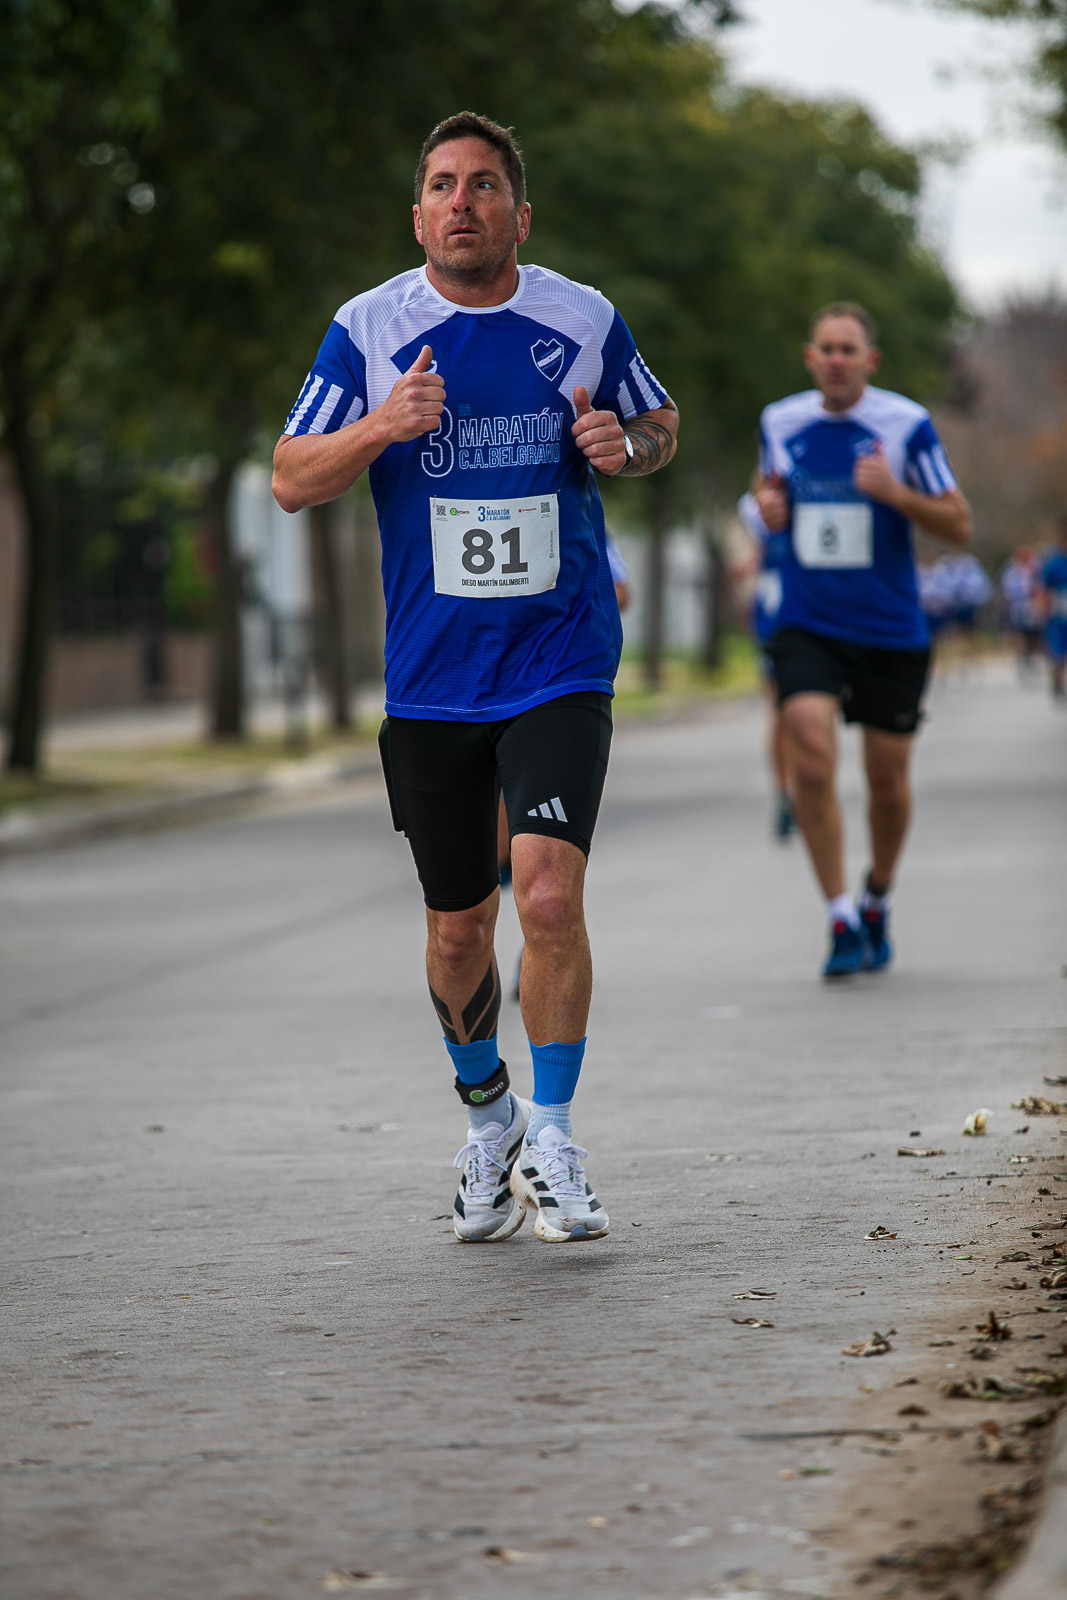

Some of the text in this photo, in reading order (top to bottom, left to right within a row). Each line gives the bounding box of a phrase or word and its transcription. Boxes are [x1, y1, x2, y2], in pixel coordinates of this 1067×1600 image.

[421, 406, 454, 477] 3
[458, 407, 564, 447] MARATÓN
[477, 506, 486, 522] 3
[461, 527, 528, 575] 81
[461, 577, 529, 587] DIEGO MARTÍN GALIMBERTI
